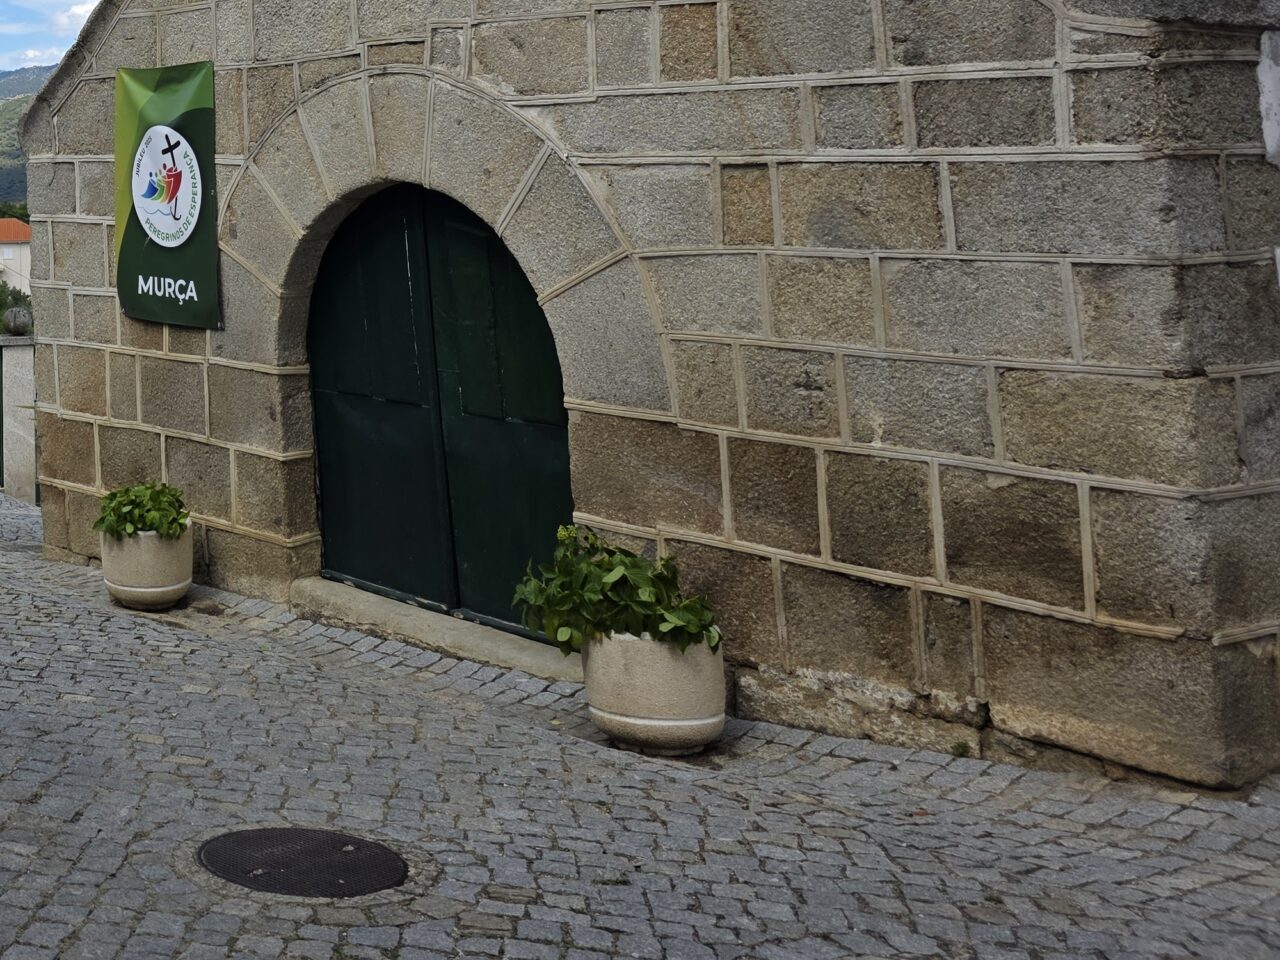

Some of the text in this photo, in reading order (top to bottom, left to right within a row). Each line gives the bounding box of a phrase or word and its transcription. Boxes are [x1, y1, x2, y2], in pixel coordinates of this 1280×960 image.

[144, 150, 198, 242] PEREGRINOS DE ESPERANÇA
[137, 274, 198, 305] MURÇA
